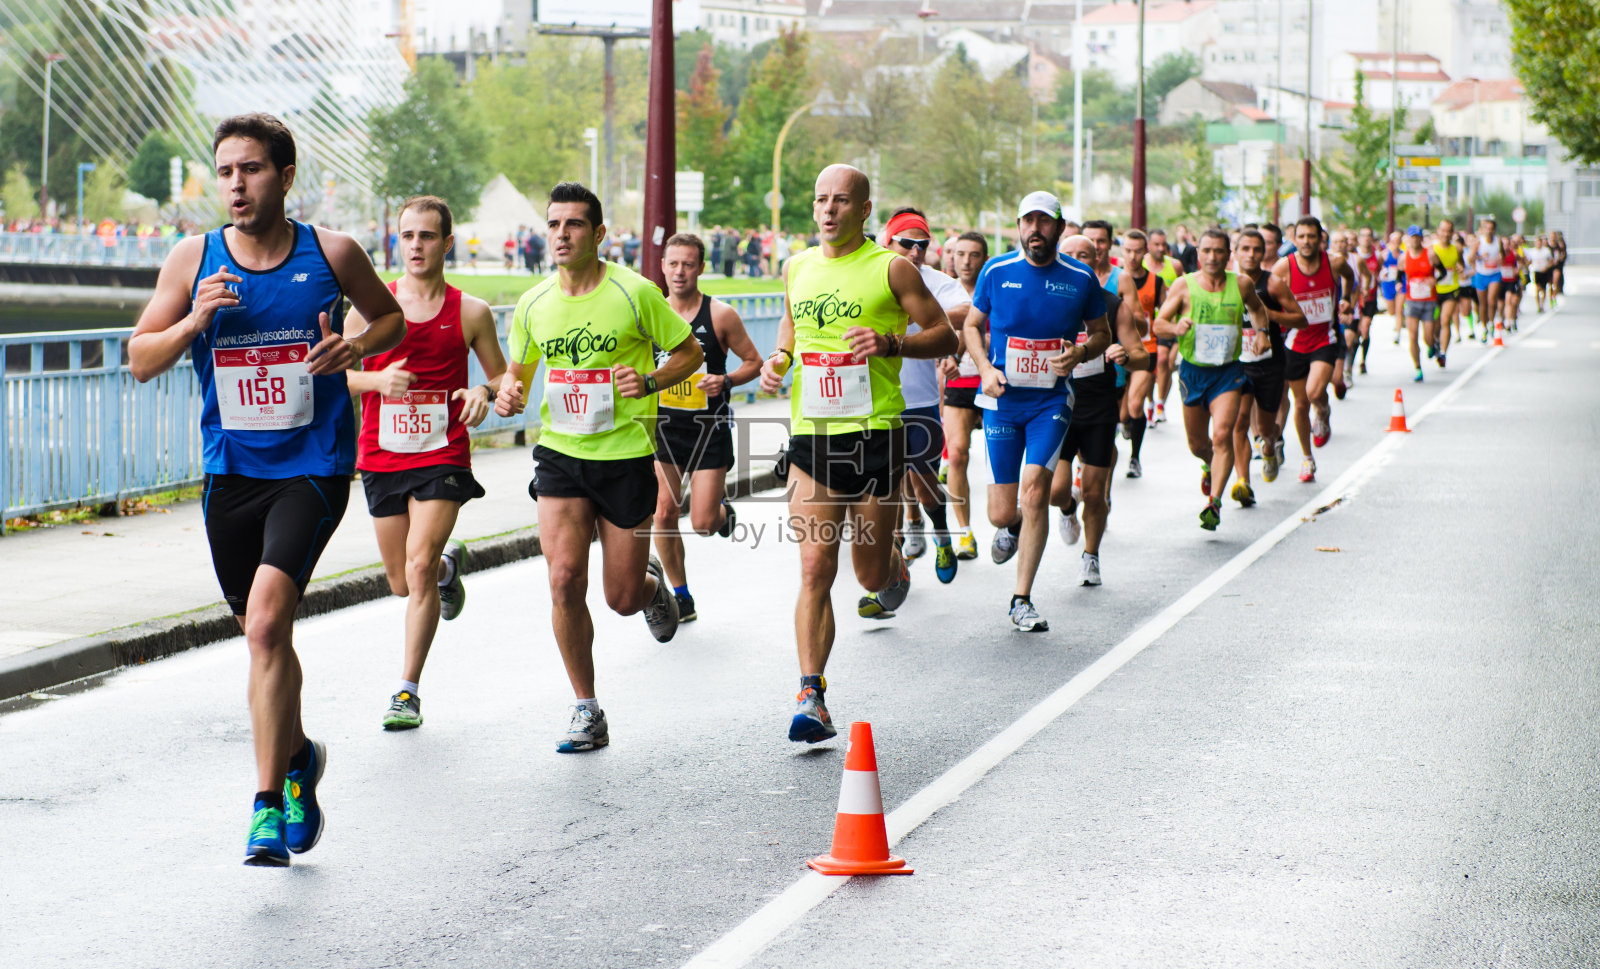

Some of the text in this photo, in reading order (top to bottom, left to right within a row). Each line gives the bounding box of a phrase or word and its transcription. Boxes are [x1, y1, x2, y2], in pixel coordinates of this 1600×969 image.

[215, 326, 315, 347] www.casalyasociados.es
[1016, 357, 1049, 374] 1364
[237, 376, 287, 406] 1158
[819, 376, 842, 398] 101
[563, 393, 588, 415] 107
[392, 413, 431, 434] 1535
